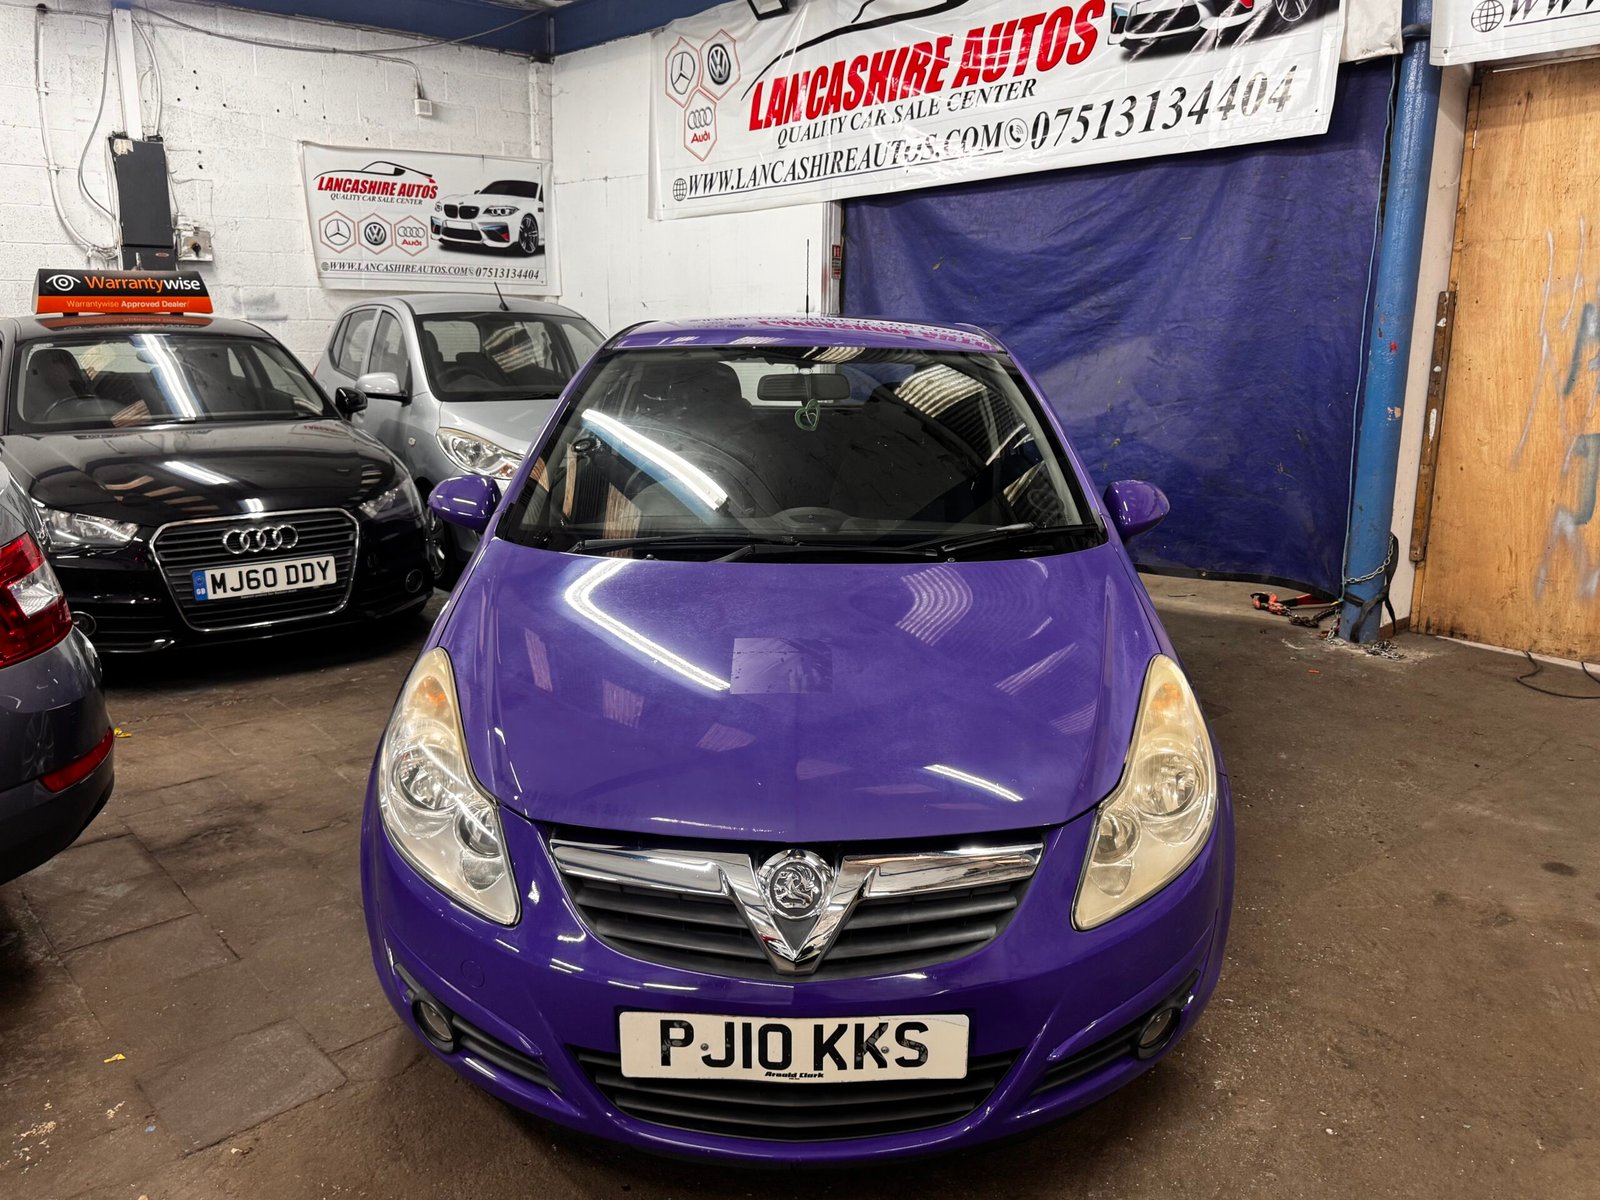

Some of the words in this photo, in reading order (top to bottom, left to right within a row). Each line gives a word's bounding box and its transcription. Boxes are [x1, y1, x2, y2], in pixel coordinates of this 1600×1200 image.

[749, 34, 953, 131] LANCASHIRE
[952, 0, 1105, 88] AUTOS
[777, 115, 847, 149] QUALITY
[850, 107, 887, 130] CAR
[891, 98, 941, 124] SALE
[947, 78, 1036, 112] CENTER
[1030, 65, 1298, 150] 07513134404
[691, 132, 710, 144] Audi
[317, 176, 397, 196] LANCASHIRE
[397, 182, 438, 200] AUTOS
[331, 193, 361, 202] QUALITY
[378, 196, 395, 204] SALE
[396, 197, 423, 206] CENTER
[402, 238, 423, 247] Audi
[330, 261, 468, 276] WWW.LANCASHIREAUTOS.COM
[475, 266, 540, 280] 07513134404
[84, 275, 201, 293] Warrantywise
[66, 299, 119, 309] Warrantywise
[121, 300, 160, 308] Approved
[210, 567, 278, 595] MJ60
[285, 560, 330, 586] DDY
[660, 1019, 793, 1071] PJ10
[813, 1021, 929, 1071] KKS
